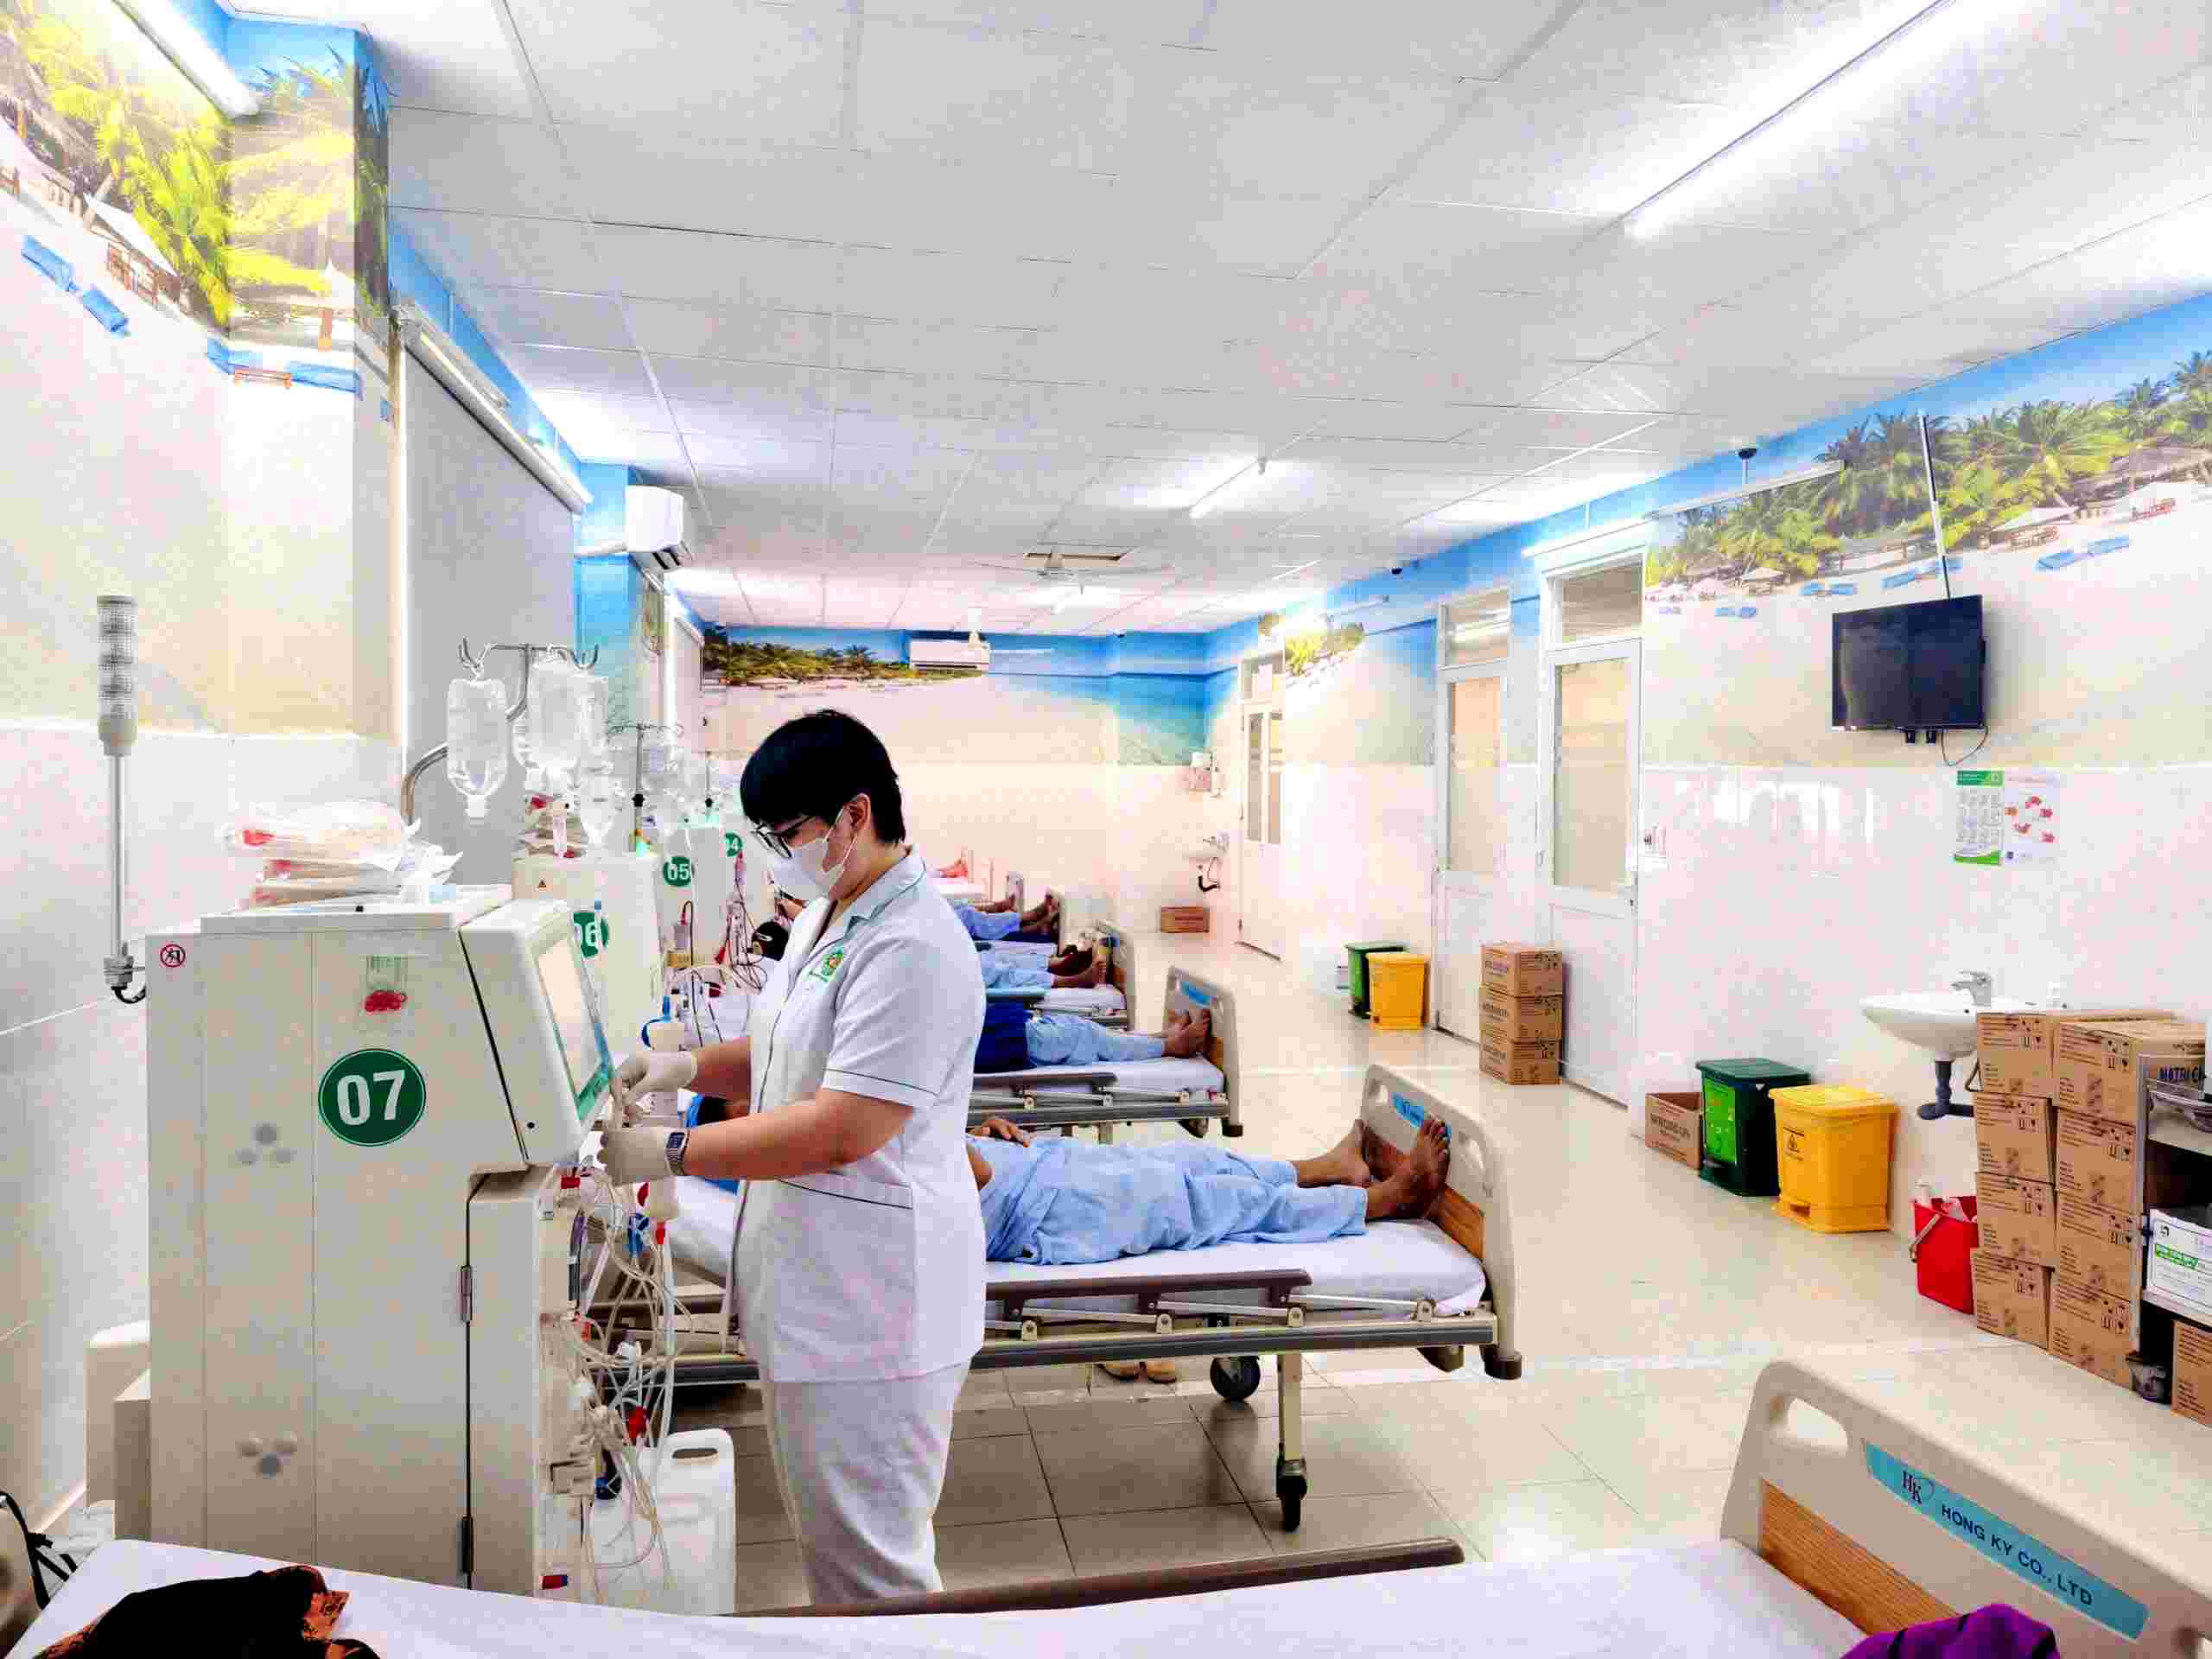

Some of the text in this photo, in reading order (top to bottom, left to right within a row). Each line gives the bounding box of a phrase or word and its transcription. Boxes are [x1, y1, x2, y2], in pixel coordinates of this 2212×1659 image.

[668, 863, 690, 880] 05
[337, 1069, 405, 1126] 07
[1902, 1470, 1923, 1504] HK
[1941, 1503, 1986, 1541] HONG
[1990, 1534, 2012, 1556] KY
[2056, 1573, 2093, 1605] LTD
